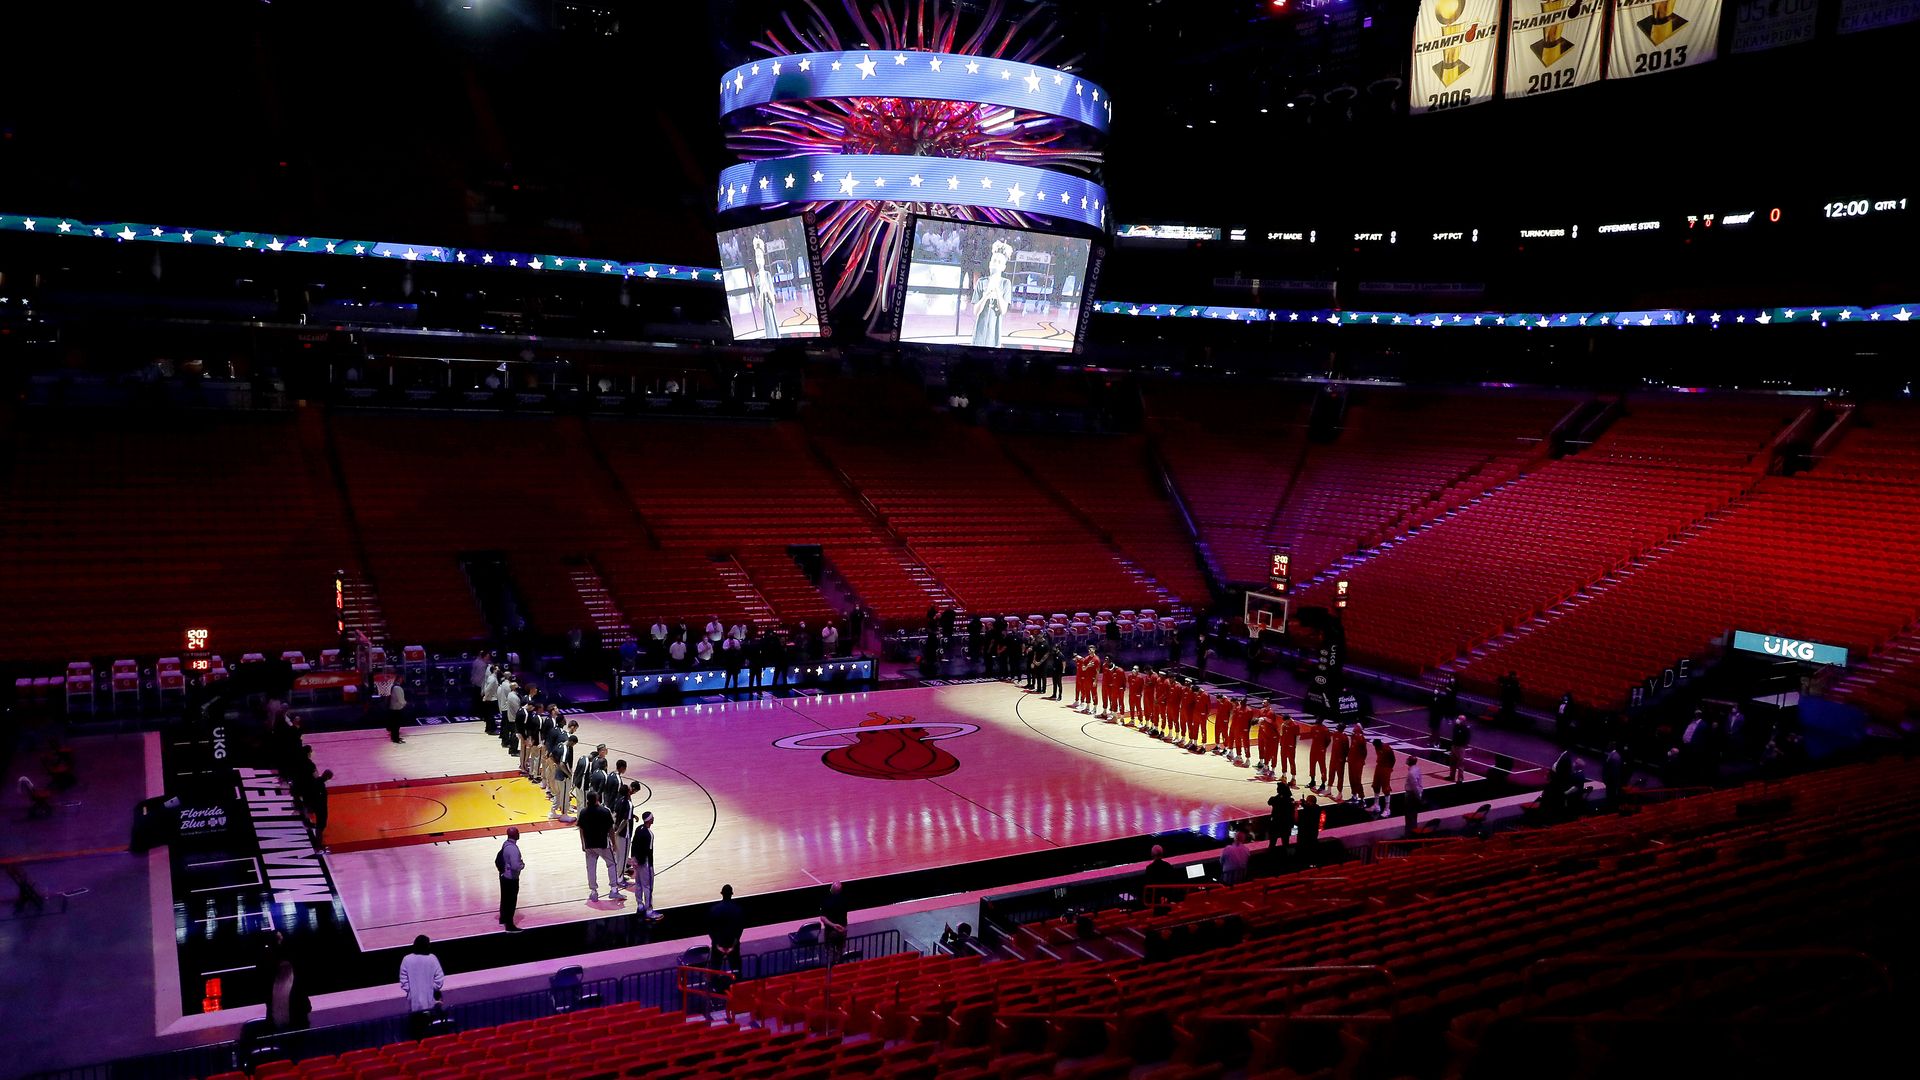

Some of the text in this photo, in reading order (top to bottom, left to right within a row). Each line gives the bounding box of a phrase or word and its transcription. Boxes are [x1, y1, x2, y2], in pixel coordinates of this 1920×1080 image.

[1634, 45, 1688, 74] 2013
[1527, 68, 1576, 95] 2012
[1427, 88, 1471, 112] 2006
[1769, 207, 1781, 222] 0
[1824, 198, 1907, 218] 12:00 QTR 1
[1520, 229, 1565, 238] TURNOVERS
[1598, 220, 1660, 233] OFFENSIVE STATS
[1267, 232, 1283, 240] 3-PT
[1354, 233, 1370, 241] 3-PT
[1432, 233, 1448, 241] 3-PT
[1448, 232, 1463, 240] PCT
[806, 225, 829, 324] MICCOSUKEE.COM
[893, 228, 910, 329] MICCOSUKEE.COM
[1077, 257, 1103, 345] MICCOSUKEE.COM
[1273, 562, 1287, 575] 24
[187, 629, 208, 639] 12:00
[188, 638, 204, 649] 24
[1631, 659, 1690, 707] HYDE
[180, 805, 225, 819] Florida
[180, 818, 206, 830] Blue
